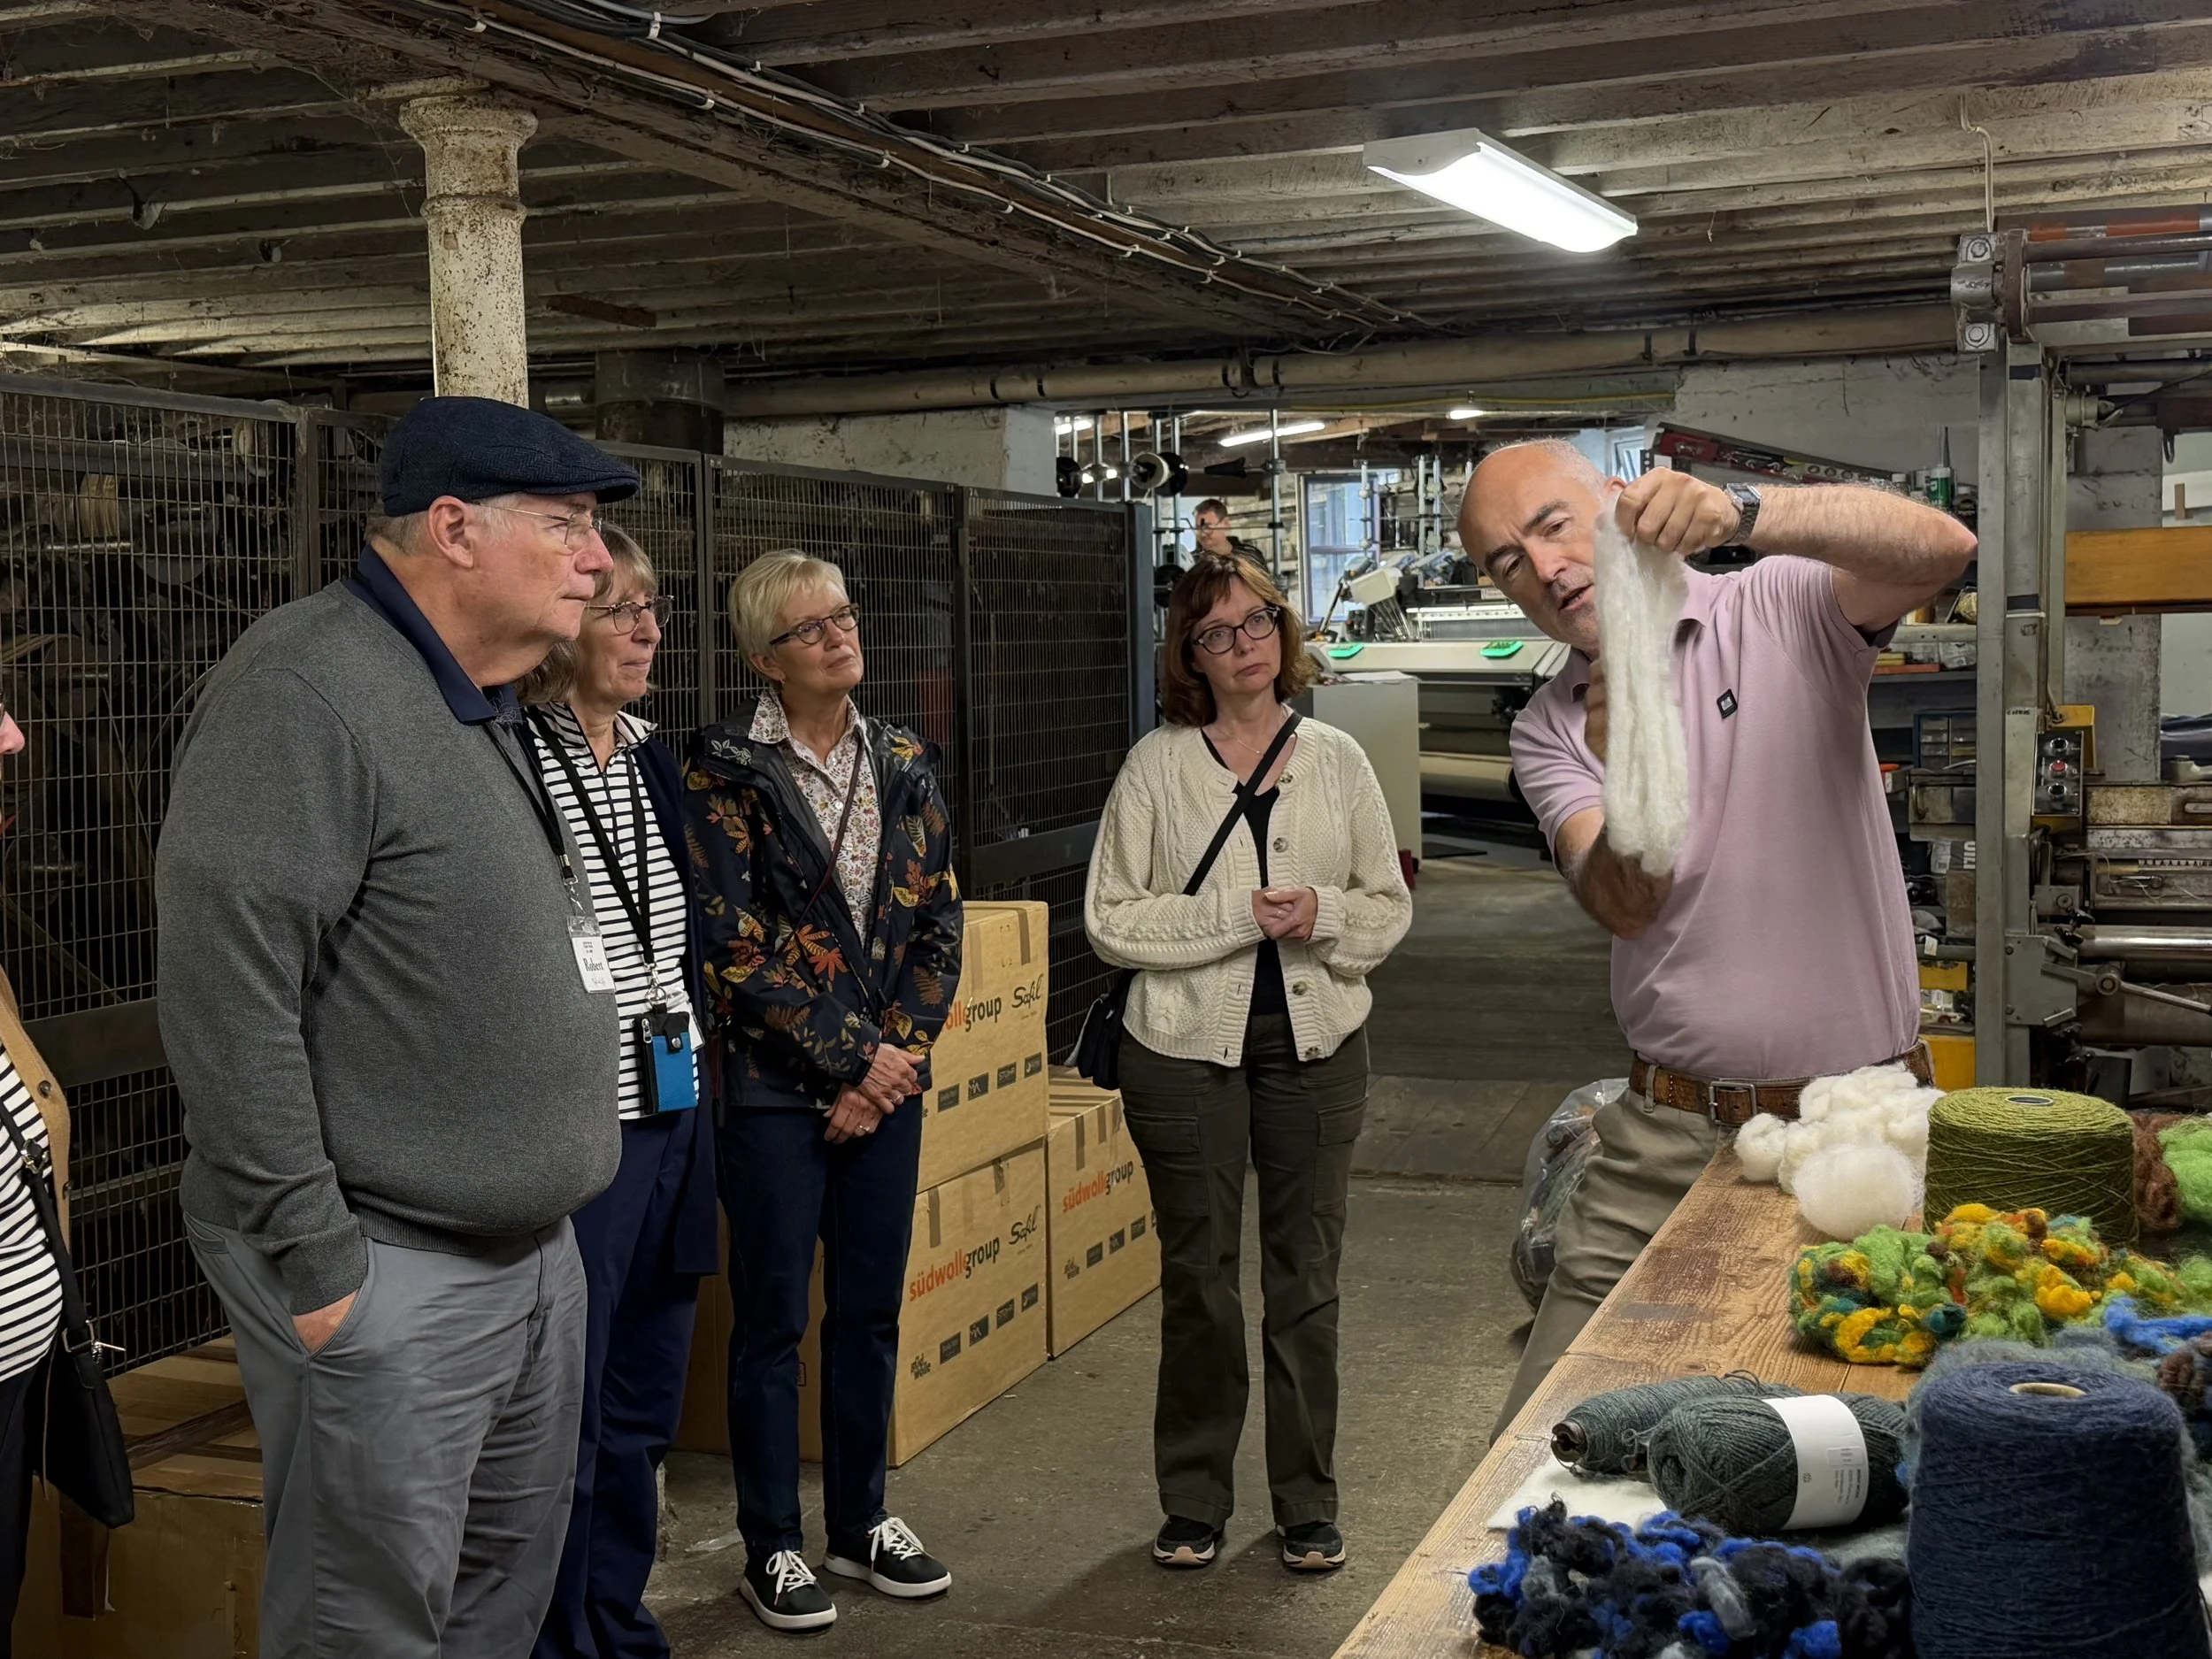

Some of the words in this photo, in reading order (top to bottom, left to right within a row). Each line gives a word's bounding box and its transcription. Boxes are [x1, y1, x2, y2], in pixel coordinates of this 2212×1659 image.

[582, 957, 604, 972] Robert
[1011, 972, 1044, 1010] Safil
[1009, 1204, 1041, 1245] Safil
